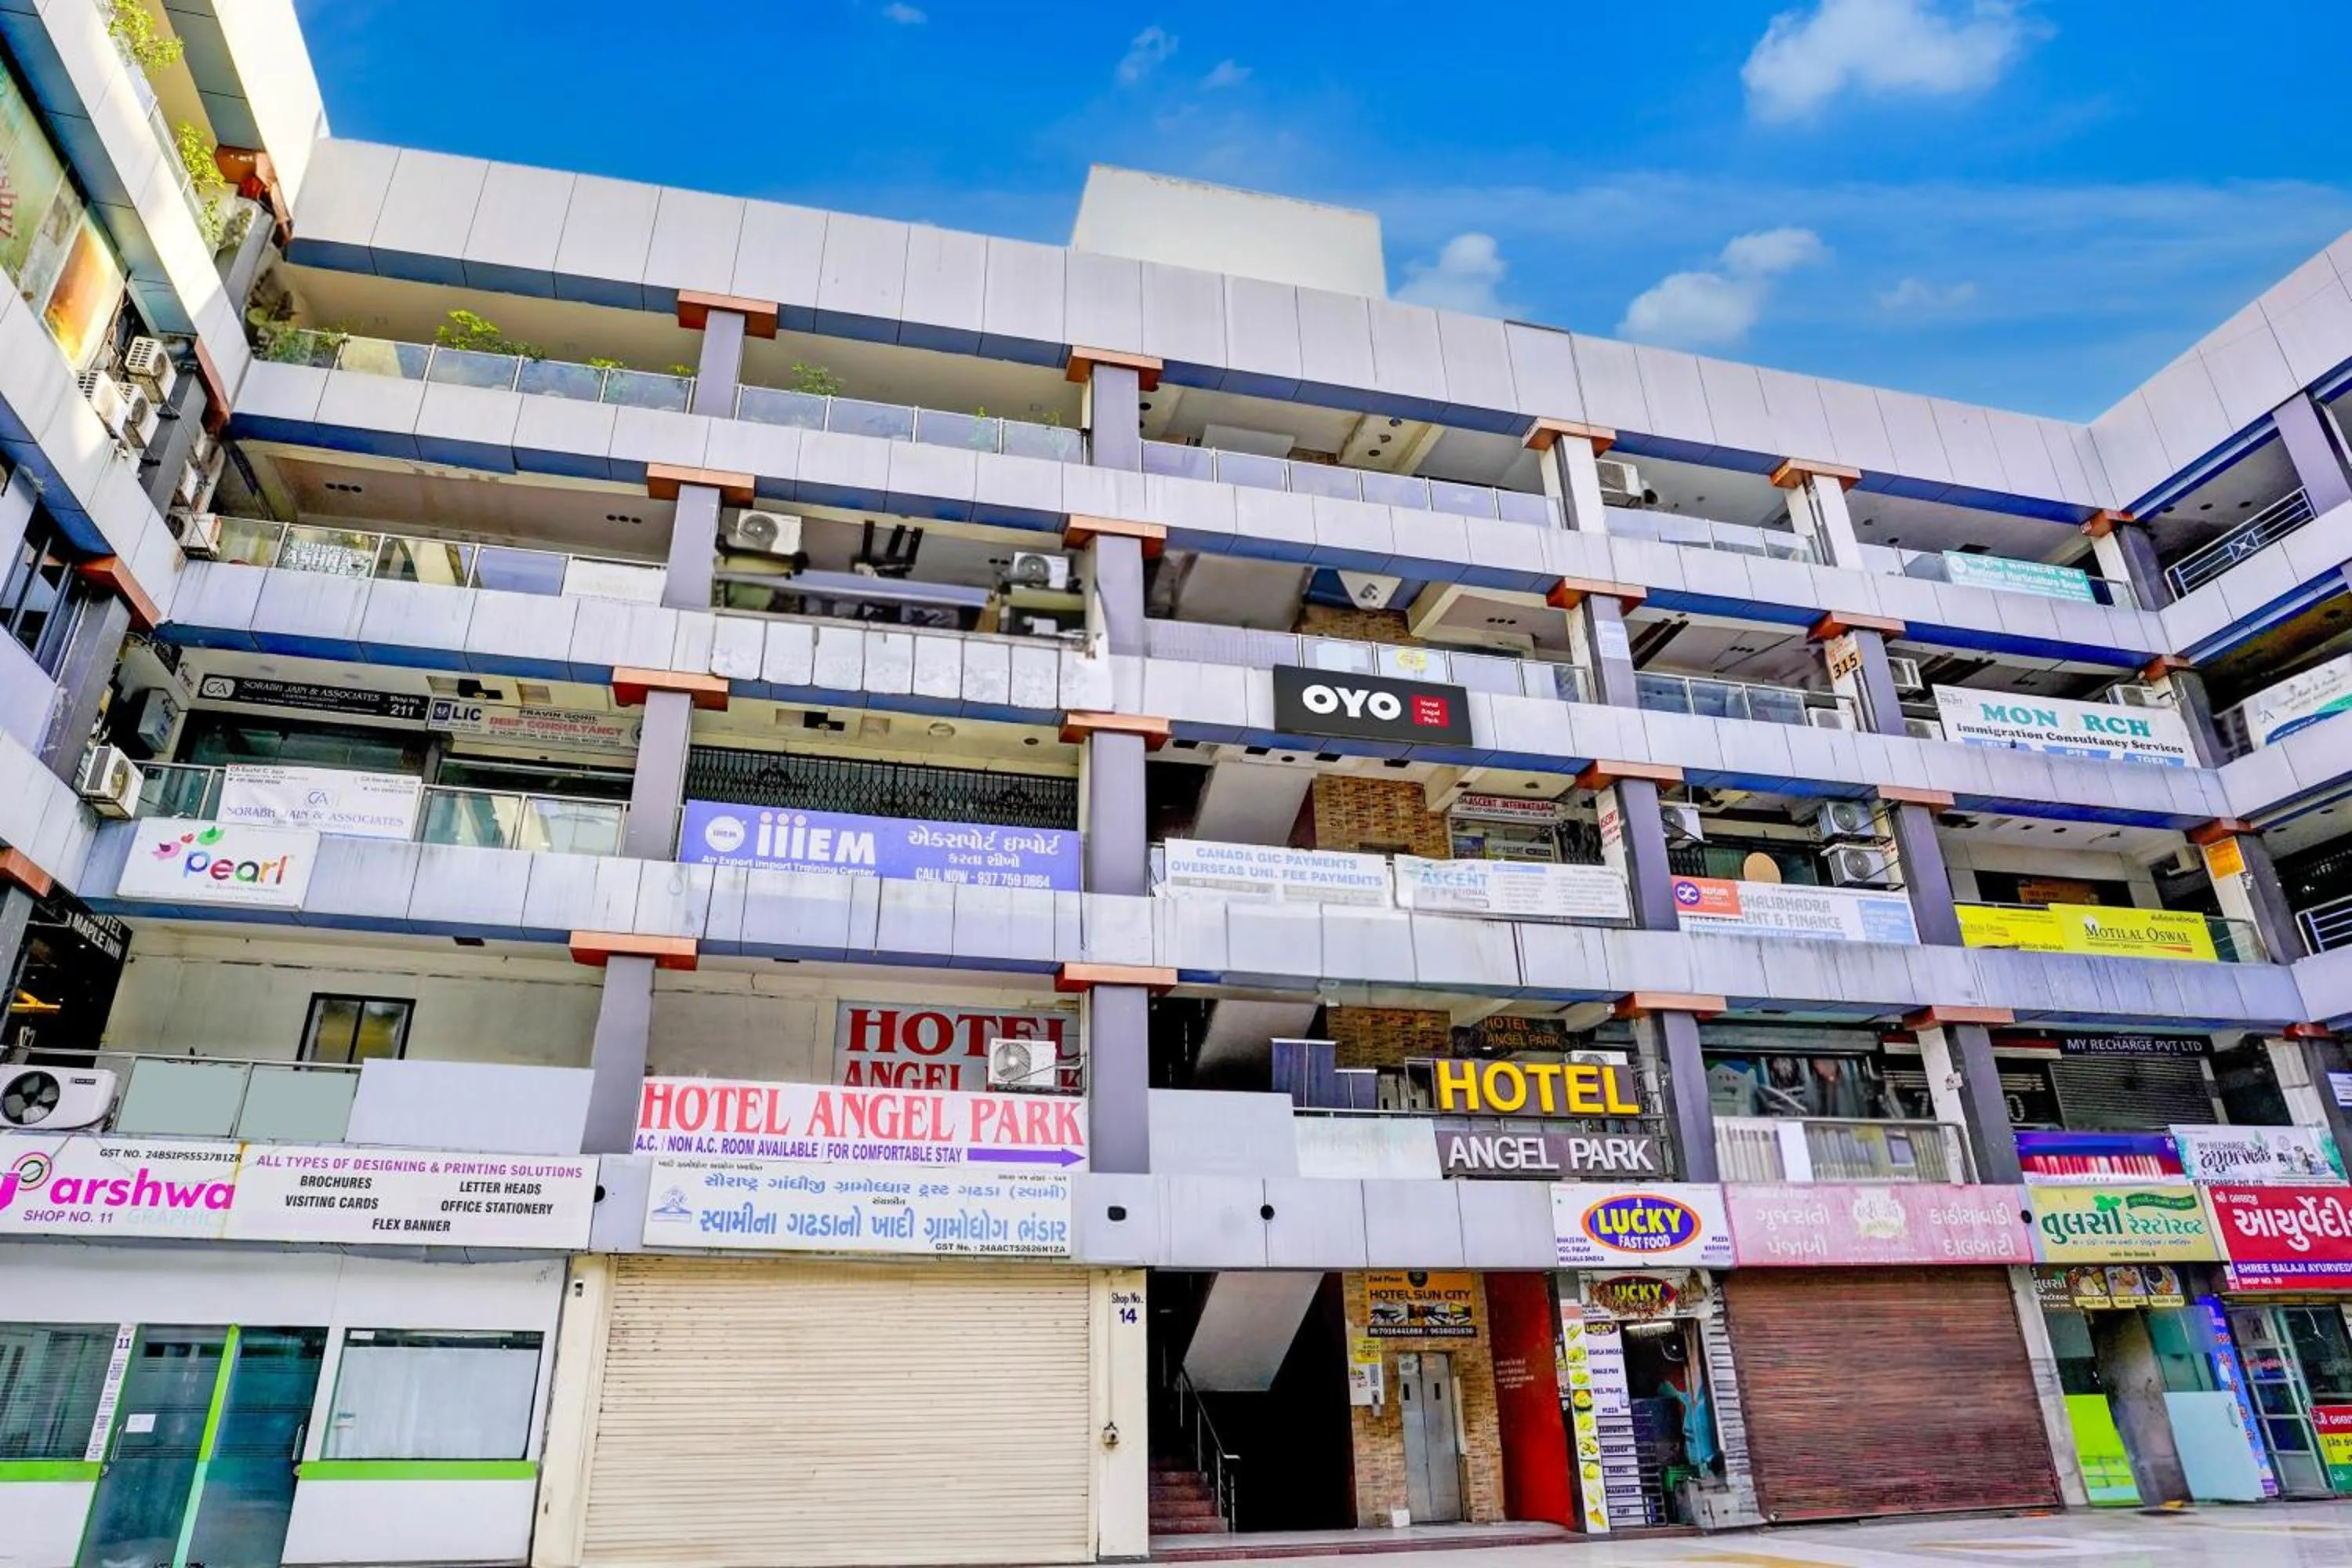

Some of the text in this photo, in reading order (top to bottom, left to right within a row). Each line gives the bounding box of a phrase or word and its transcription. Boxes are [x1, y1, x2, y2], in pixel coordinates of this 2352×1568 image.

[1833, 652, 1857, 680] 315
[319, 688, 380, 702] ASSOCIATES
[1301, 684, 1403, 721] OYO
[390, 702, 414, 717] 211
[452, 706, 482, 722] LIC
[518, 708, 561, 719] PRAVIN
[488, 717, 526, 727] DEEP
[527, 720, 625, 736] CONSULTANCY
[1956, 721, 2184, 754] Immigration Consultancy Services
[307, 791, 329, 806] CA
[227, 806, 276, 818] SORABH
[313, 811, 324, 821] &
[328, 813, 405, 826] ASSOCIATES
[1196, 846, 1358, 870] CANADA GIC PAYMENTS
[183, 850, 288, 885] pearl
[915, 866, 940, 882] CALL
[943, 868, 969, 884] NOW
[977, 871, 998, 886] 937
[1171, 861, 1383, 887] OVERSEAS UNI. FEE PAYMENTS
[1420, 869, 1489, 887] ASCENT
[1787, 913, 1844, 931] FINANCE
[846, 1008, 1080, 1061] HOTEL
[1487, 1033, 1562, 1047] ANGEL PARK
[2066, 1038, 2202, 1052] MY RECHARGE PVT LTD
[1436, 1059, 1642, 1116] HOTEL
[637, 1081, 1085, 1146] HOTEL ANGEL PARK
[100, 1149, 121, 1159] GST
[123, 1149, 143, 1160] NO.
[634, 1134, 659, 1151] A.C.
[666, 1135, 694, 1153] NON
[695, 1137, 718, 1155] A.C.
[720, 1138, 755, 1156] ROOM
[757, 1139, 818, 1159] AVAILABLE
[827, 1142, 850, 1160] FOR
[851, 1143, 933, 1162] COMFORTABLE
[935, 1146, 963, 1163] STAY
[1448, 1135, 1656, 1171] ANGEL PARK
[256, 1154, 583, 1178] ALL TYPES OF DESIGNING & PRINTING SOLUTIONS
[299, 1175, 373, 1190] BROCHURES
[459, 1181, 543, 1195] LETTER HEADS
[957, 1185, 1000, 1198] ગઢડા
[285, 1195, 379, 1210] VISITING CARDS
[441, 1200, 554, 1215] OFFICE STATIONERY
[24, 1209, 114, 1224] SHOP NO. 11
[372, 1218, 452, 1232] FLEX BANNER
[699, 1201, 777, 1235] સ્વામીના
[786, 1204, 862, 1239] ગઢડાનો
[870, 1207, 915, 1240] ખાદી
[1018, 1210, 1067, 1243] ભંડાર
[1596, 1207, 1682, 1235] LUCKY
[1755, 1205, 1831, 1231] ગુજરાતી
[2041, 1203, 2125, 1245] તુલસી
[935, 1242, 954, 1251] GST
[1618, 1234, 1671, 1249] FAST FOOD
[2237, 1262, 2272, 1275] SHREE
[2273, 1263, 2306, 1274] BALAJI
[1111, 1292, 1144, 1305] Shop No.
[1370, 1289, 1472, 1301] HOTEL SUN CITY
[1119, 1307, 1138, 1324] 14
[118, 1338, 130, 1349] 11
